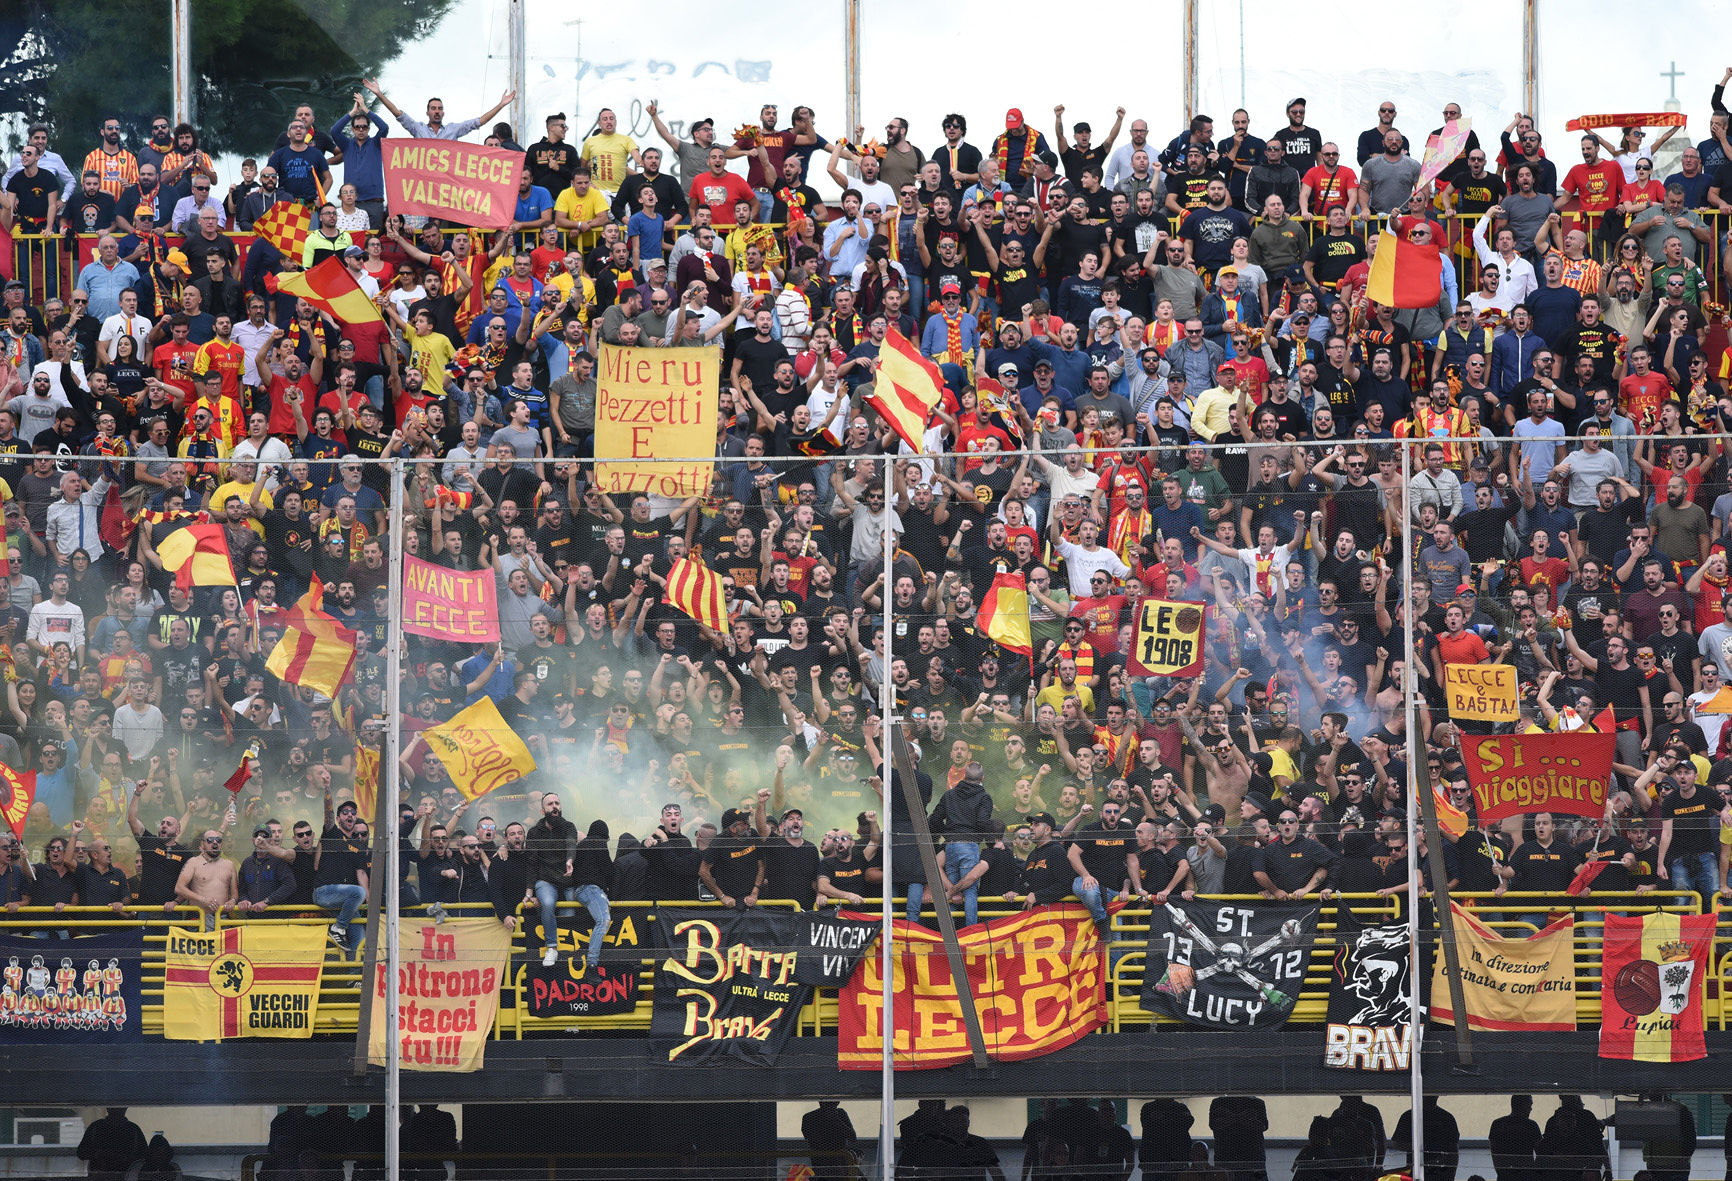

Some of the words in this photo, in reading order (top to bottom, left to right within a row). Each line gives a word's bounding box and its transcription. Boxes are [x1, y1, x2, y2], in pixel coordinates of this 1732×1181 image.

[1579, 114, 1614, 128] ODIO
[1645, 113, 1683, 128] BARI
[1286, 145, 1311, 155] LUPI
[390, 146, 451, 174] AMICS
[454, 152, 514, 186] LECCE
[1588, 172, 1605, 180] LECCE
[402, 178, 492, 217] VALENCIA
[1185, 190, 1209, 198] PASSION
[602, 347, 703, 387] Mieru
[599, 388, 703, 426] Pezzetti
[1631, 395, 1658, 405] LECCE
[632, 426, 654, 459] E
[594, 461, 711, 498] Cazzotti
[406, 563, 484, 604] AVANTI
[403, 597, 488, 636] LECCE
[1141, 605, 1173, 635] LE
[1142, 635, 1193, 667] 1908
[1445, 666, 1506, 687] LECCE
[1455, 694, 1516, 715] BASTA!
[1216, 906, 1255, 937] ST.
[170, 936, 216, 957] LECCE
[420, 926, 457, 961] In
[1162, 931, 1194, 967] 13
[1269, 949, 1303, 980] 12
[567, 954, 587, 980] U
[1441, 966, 1496, 990] otinata
[249, 993, 313, 1012] VECCHI
[569, 1002, 589, 1012] 1998
[763, 989, 790, 1004] LECCE
[1186, 988, 1264, 1026] LUCY
[401, 1034, 463, 1066] tu!!!
[1325, 1022, 1426, 1072] BRAV
